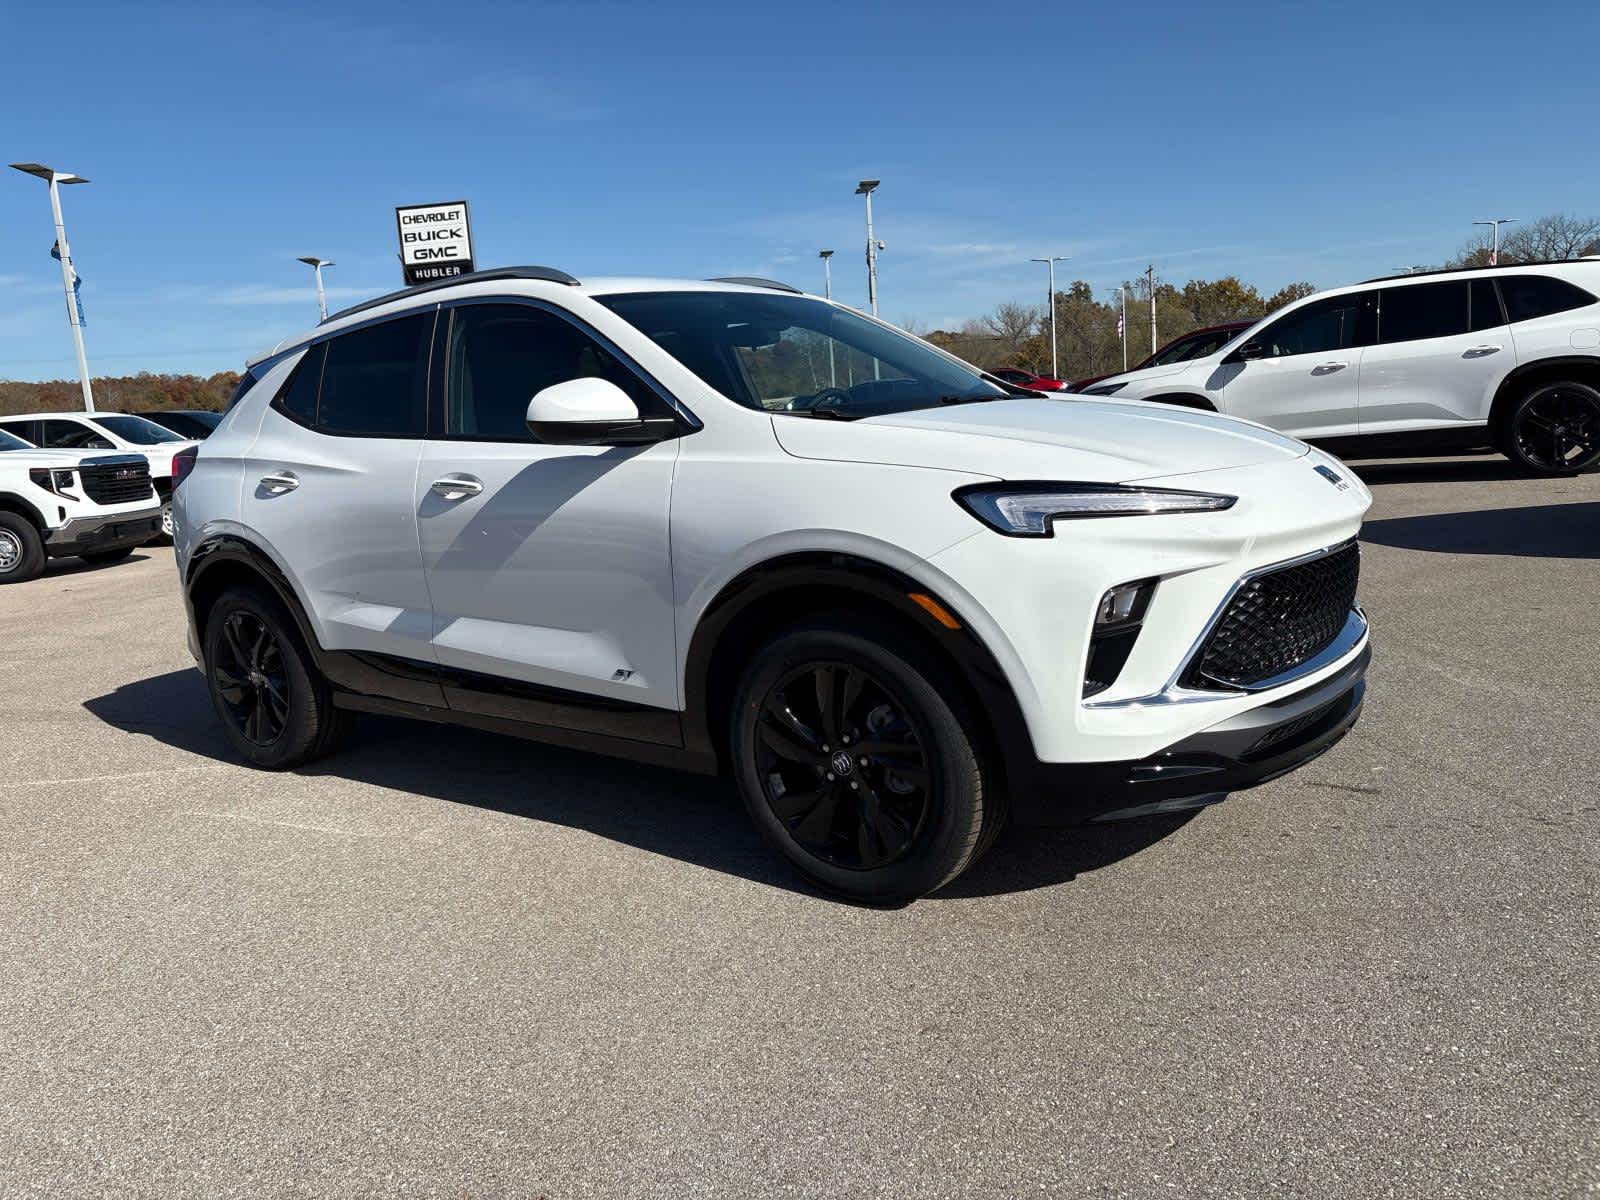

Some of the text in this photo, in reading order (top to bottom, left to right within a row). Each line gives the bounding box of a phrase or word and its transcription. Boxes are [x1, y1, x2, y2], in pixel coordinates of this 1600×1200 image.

[402, 211, 460, 225] CHEVROLET
[404, 228, 463, 243] BUICK
[413, 246, 458, 260] GMC
[416, 266, 460, 278] HUBLER
